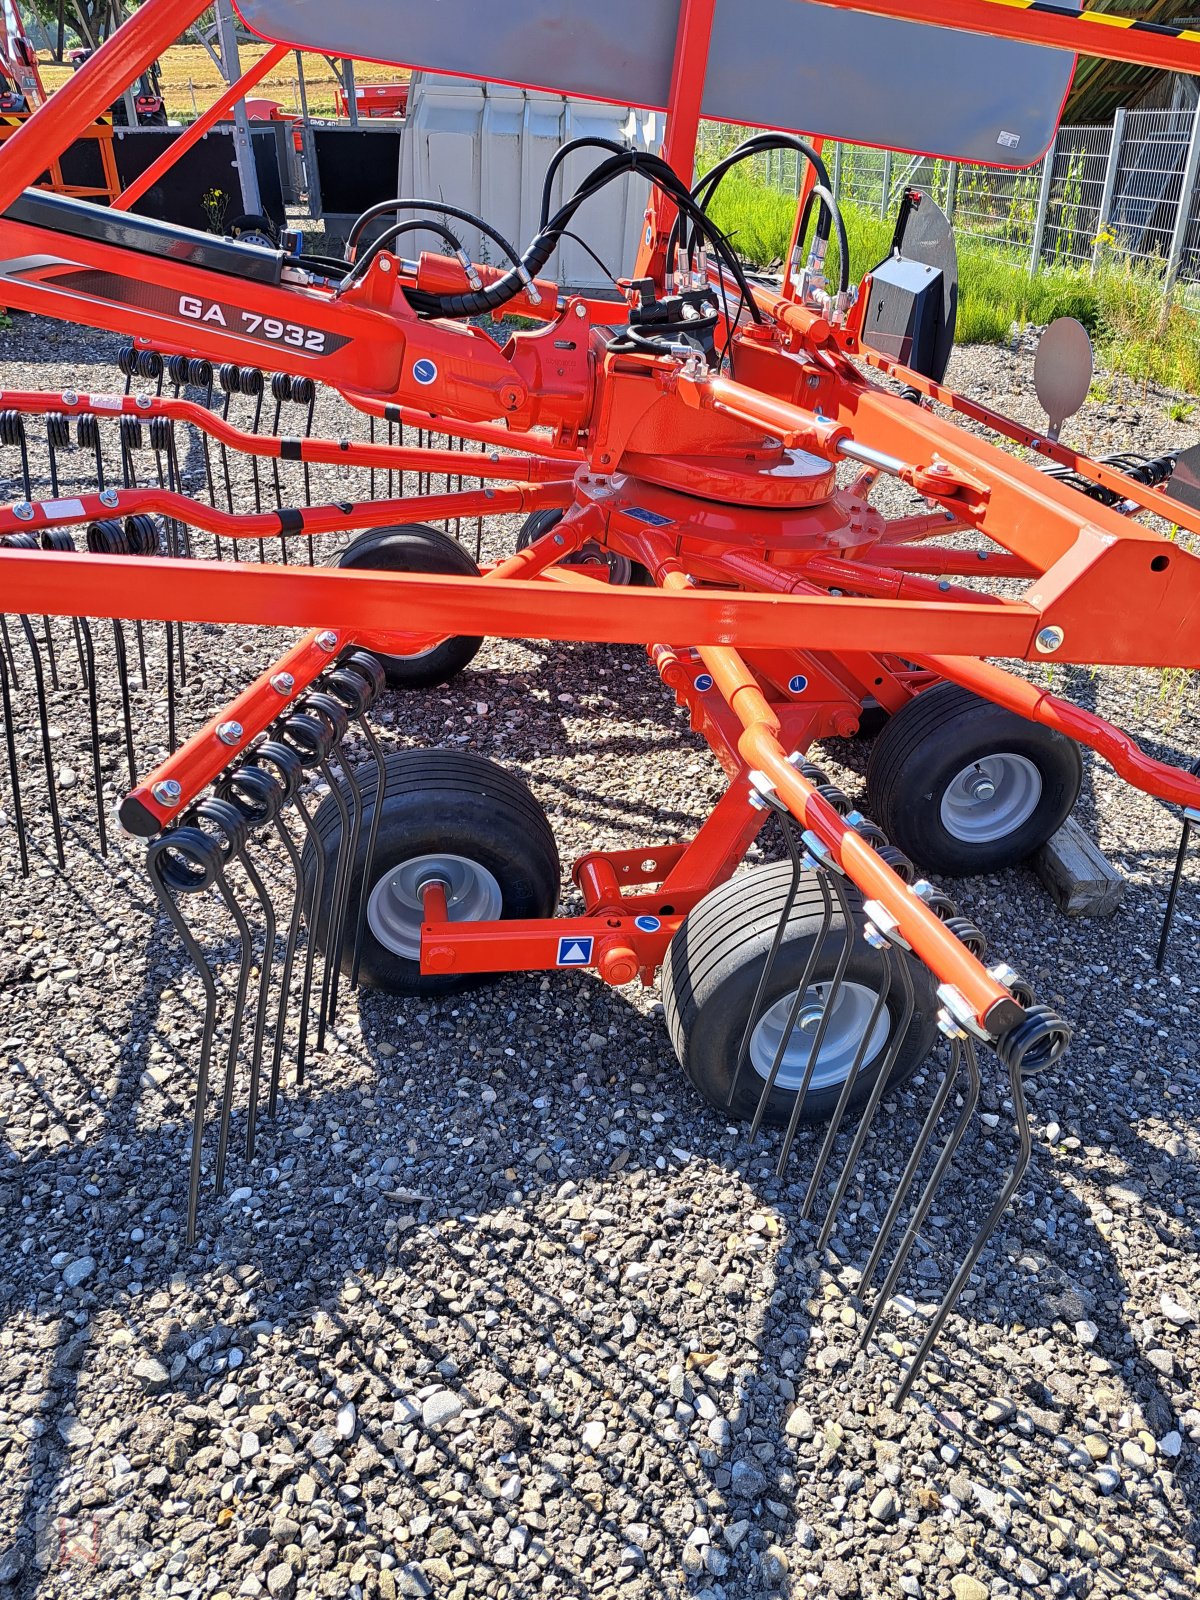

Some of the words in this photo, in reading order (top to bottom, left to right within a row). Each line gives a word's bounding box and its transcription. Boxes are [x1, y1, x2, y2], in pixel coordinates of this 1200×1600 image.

[310, 119, 325, 127] GMD
[178, 295, 227, 327] GA
[241, 311, 326, 352] 7932
